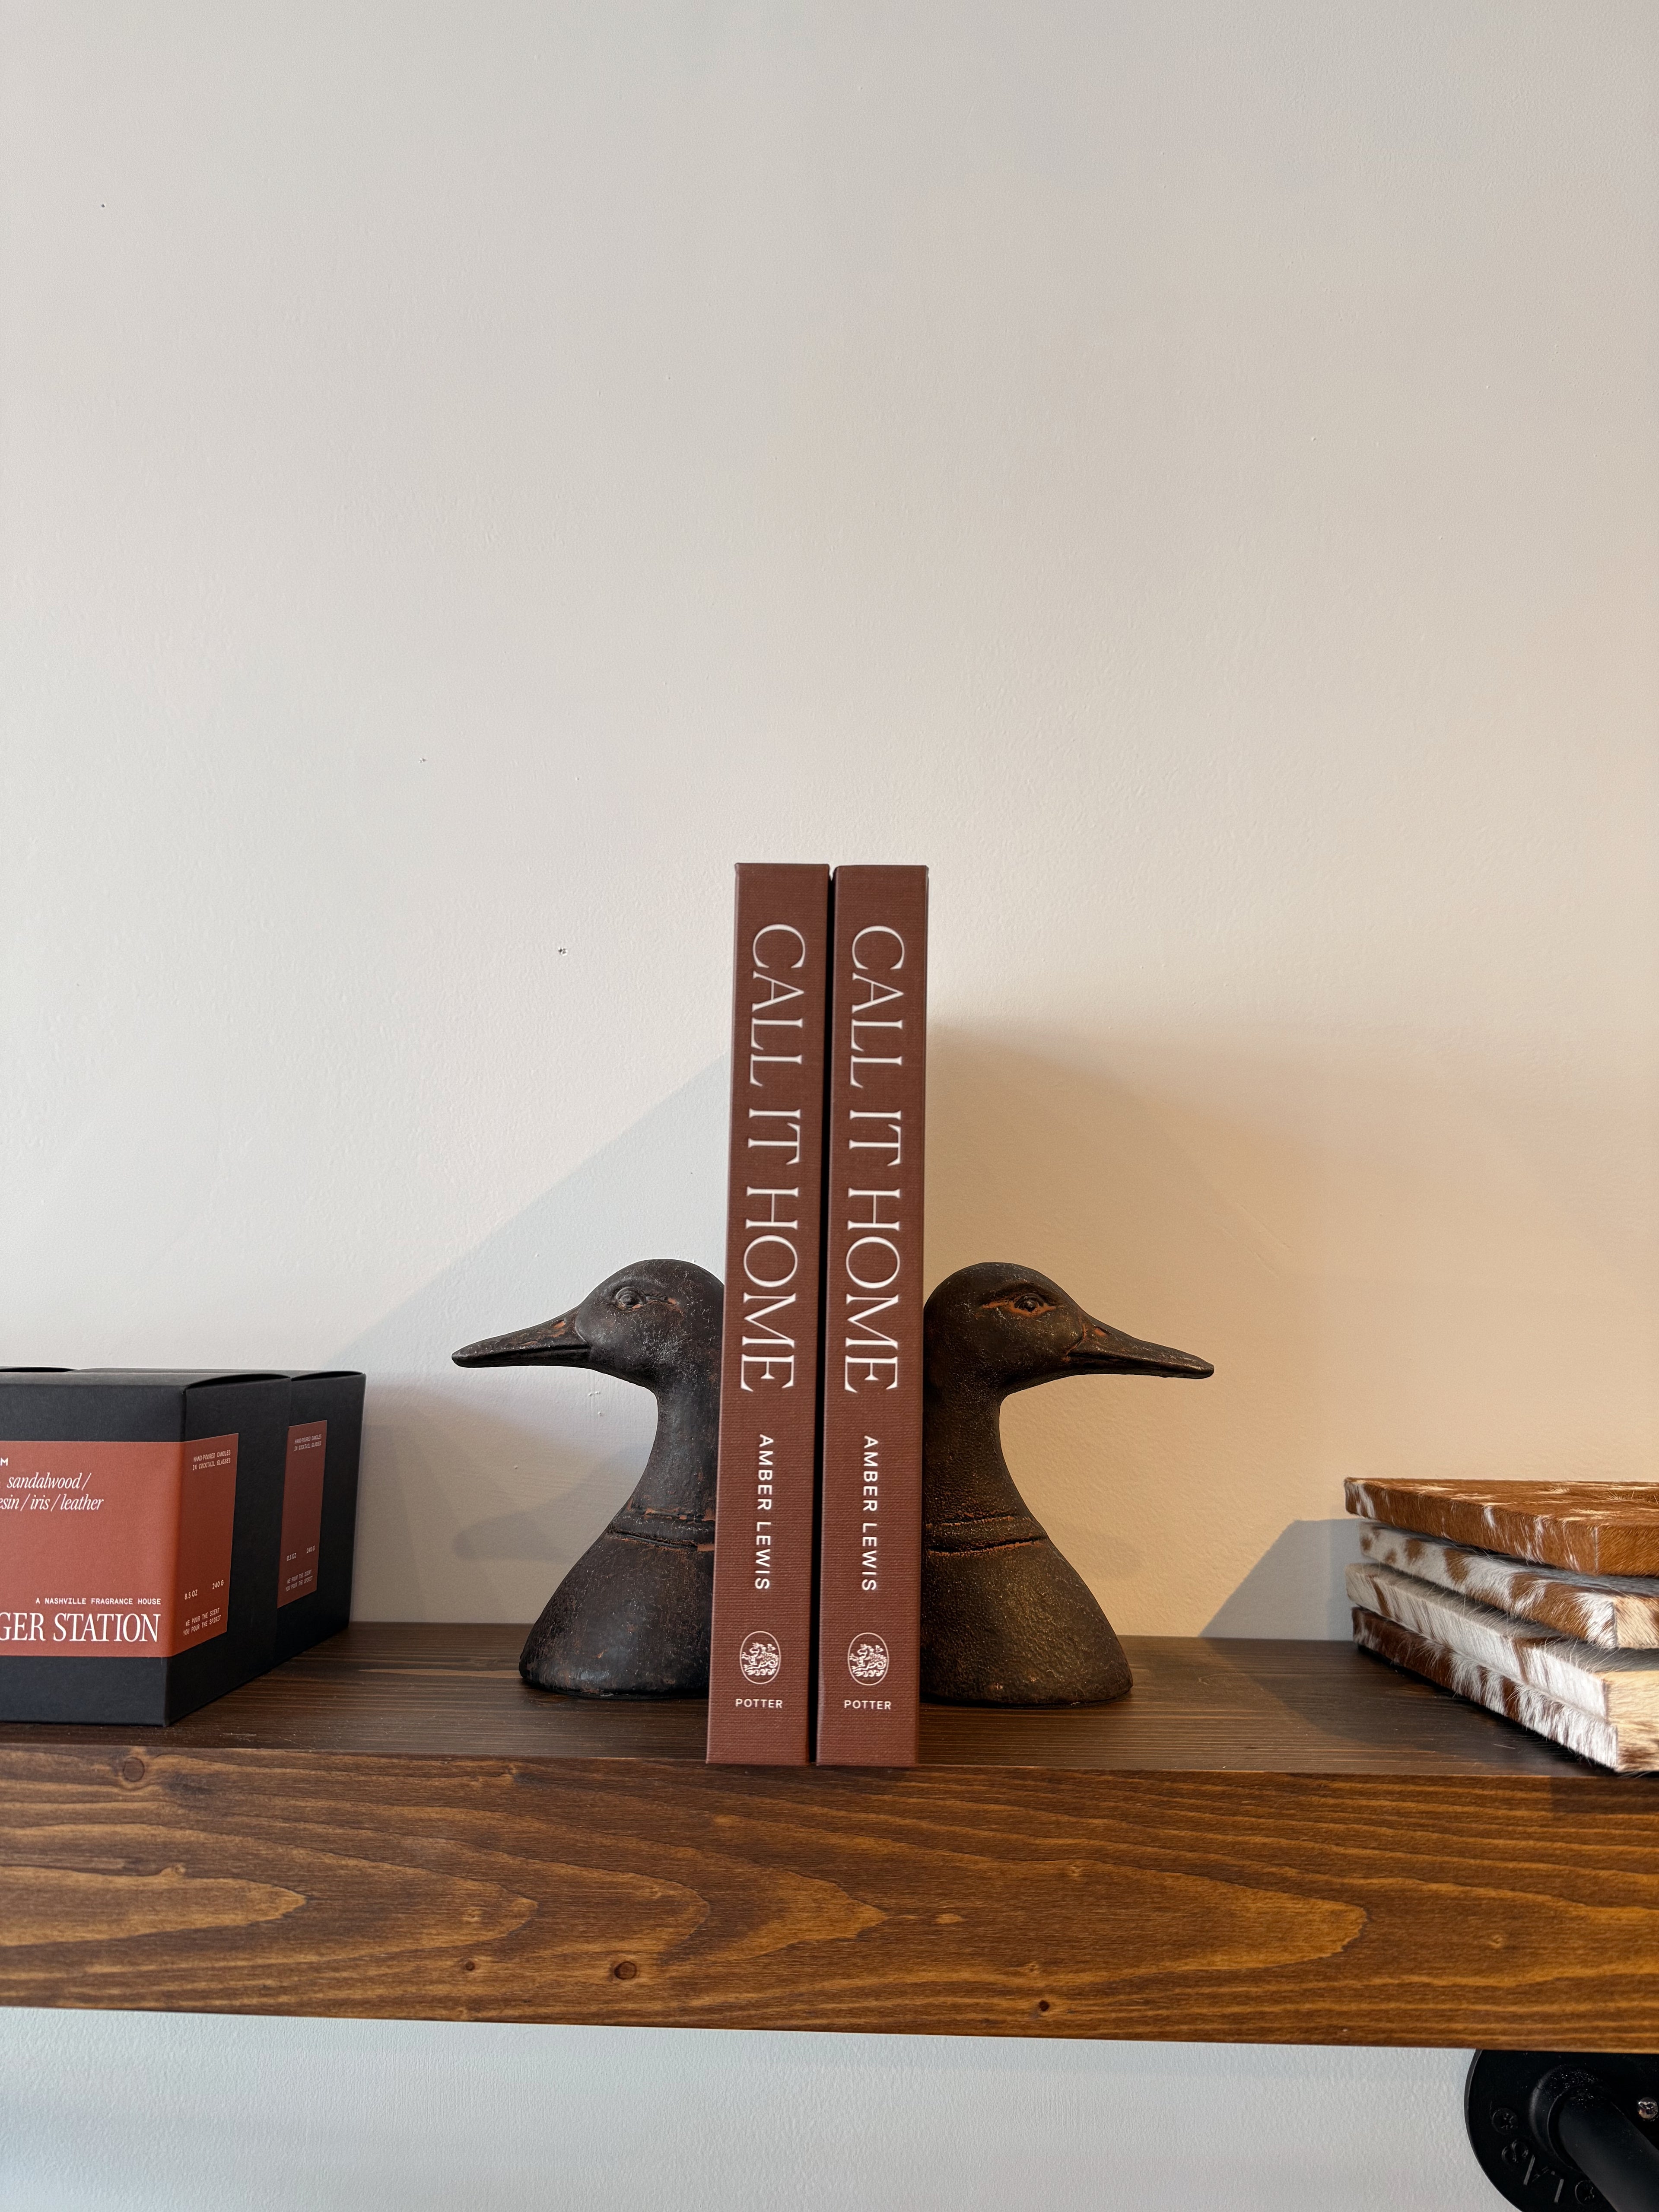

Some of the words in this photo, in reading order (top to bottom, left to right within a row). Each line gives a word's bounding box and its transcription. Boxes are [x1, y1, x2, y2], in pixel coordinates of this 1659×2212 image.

[750, 924, 806, 1087] CALL
[850, 925, 905, 1088] CALL
[747, 1108, 801, 1165] IT
[849, 1109, 902, 1166] IT
[741, 1186, 799, 1392] HOME
[844, 1188, 900, 1393] HOME
[193, 1452, 216, 1462] HAND-POURED
[217, 1449, 231, 1458] CANDLES
[199, 1461, 216, 1469] COCKTAIL
[217, 1457, 231, 1466] GLASSES
[6, 1472, 83, 1489] sandalwood
[757, 1433, 774, 1510] AMBER
[863, 1435, 879, 1512] AMBER
[30, 1494, 51, 1510] iris
[60, 1494, 104, 1510] leather
[754, 1521, 772, 1589] LEWIS
[861, 1522, 877, 1591] LEWIS
[191, 1589, 198, 1597] OZ
[212, 1581, 220, 1589] 240
[53, 1613, 162, 1642] STATION
[191, 1615, 200, 1624] POUR
[210, 1607, 220, 1616] SCENT
[191, 1624, 200, 1633] POUR
[209, 1615, 221, 1624] SPIRIT
[735, 1698, 782, 1708] POTTER
[844, 1700, 891, 1710] POTTER
